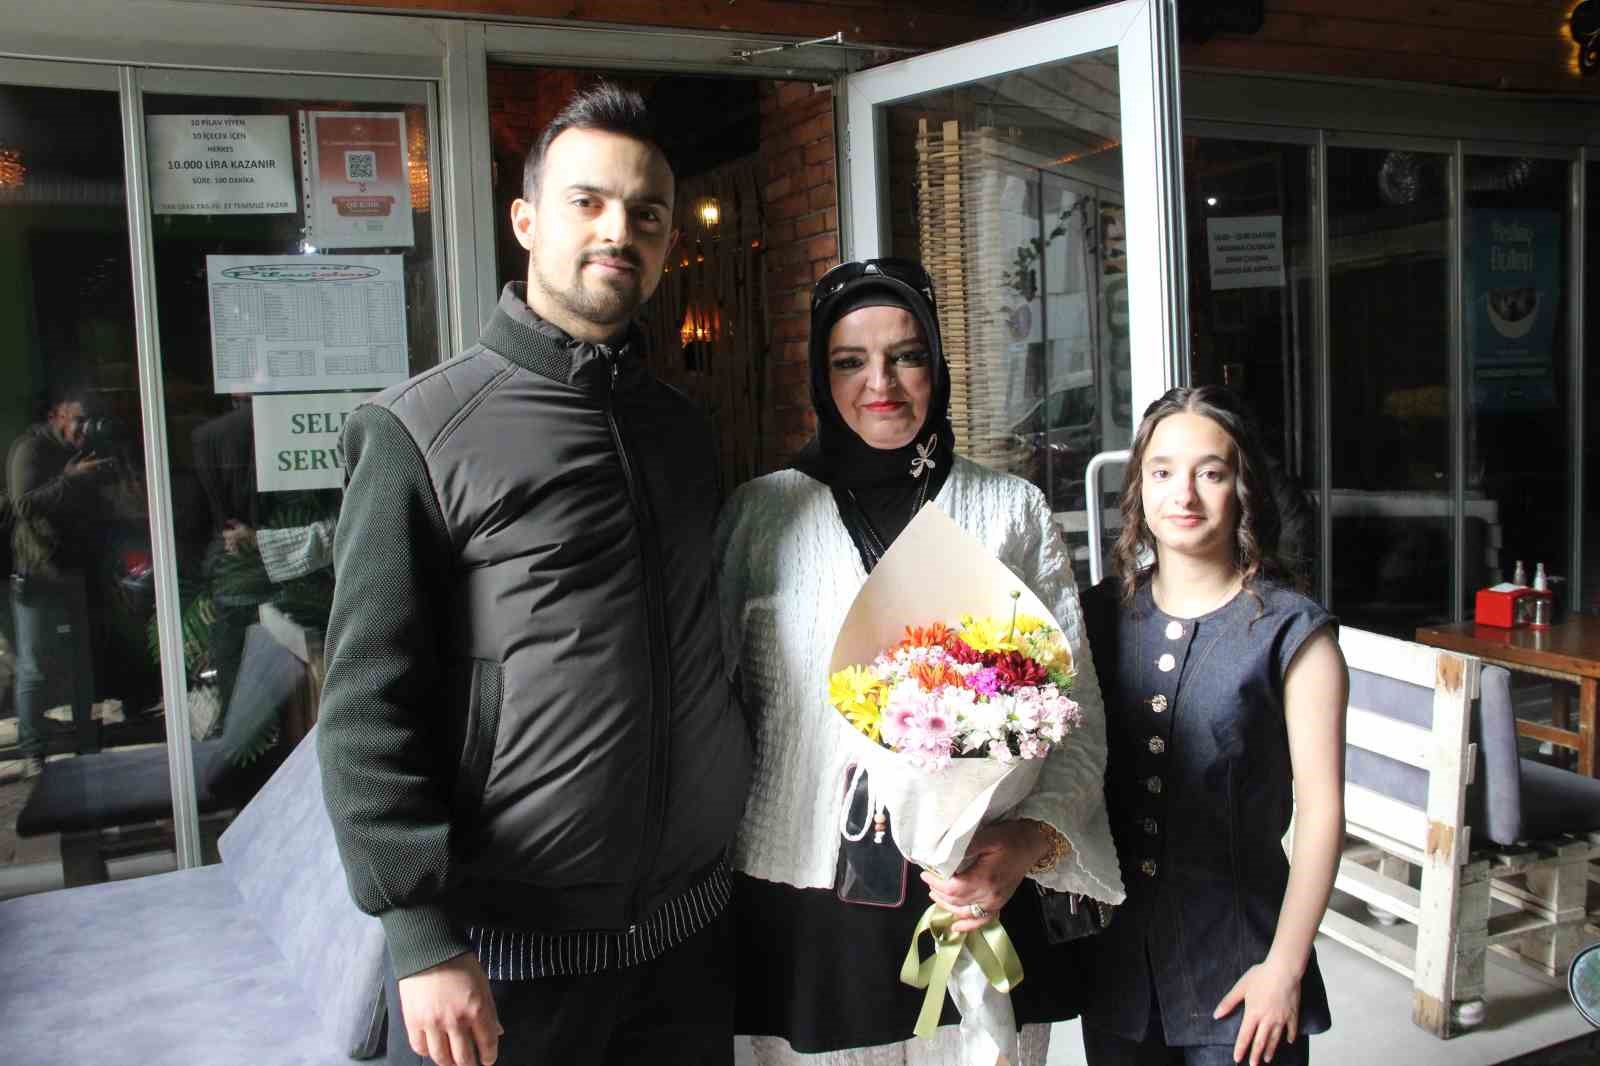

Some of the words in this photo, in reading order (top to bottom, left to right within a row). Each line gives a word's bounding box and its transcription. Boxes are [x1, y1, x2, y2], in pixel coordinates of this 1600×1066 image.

[167, 159, 202, 170] 10.000
[205, 158, 228, 169] LİRA
[230, 159, 276, 169] KAZANIR
